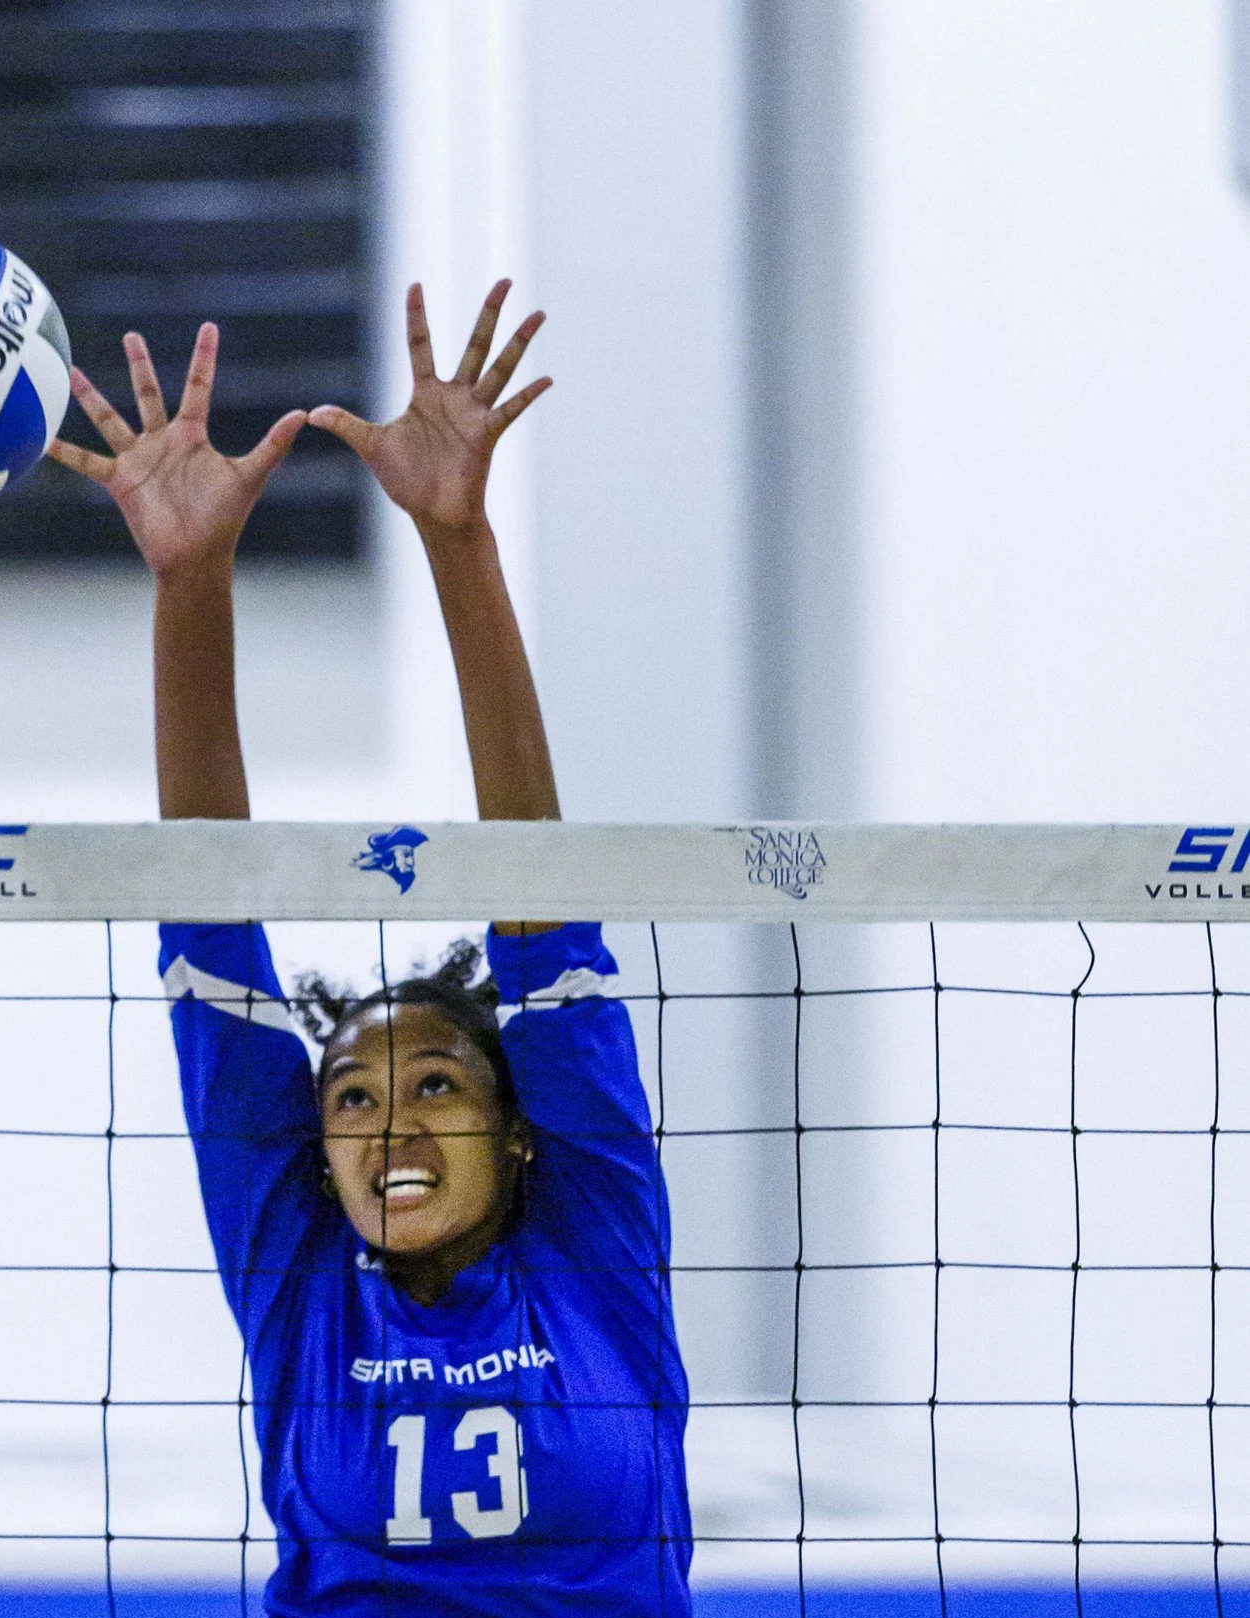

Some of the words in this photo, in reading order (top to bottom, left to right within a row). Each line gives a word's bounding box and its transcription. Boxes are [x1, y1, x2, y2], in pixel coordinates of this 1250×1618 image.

[750, 826, 819, 849] SANTA
[744, 848, 827, 868] MONICA
[748, 867, 824, 892] COLLEGE
[1145, 884, 1250, 899] VOLLE
[386, 1405, 530, 1546] 13
